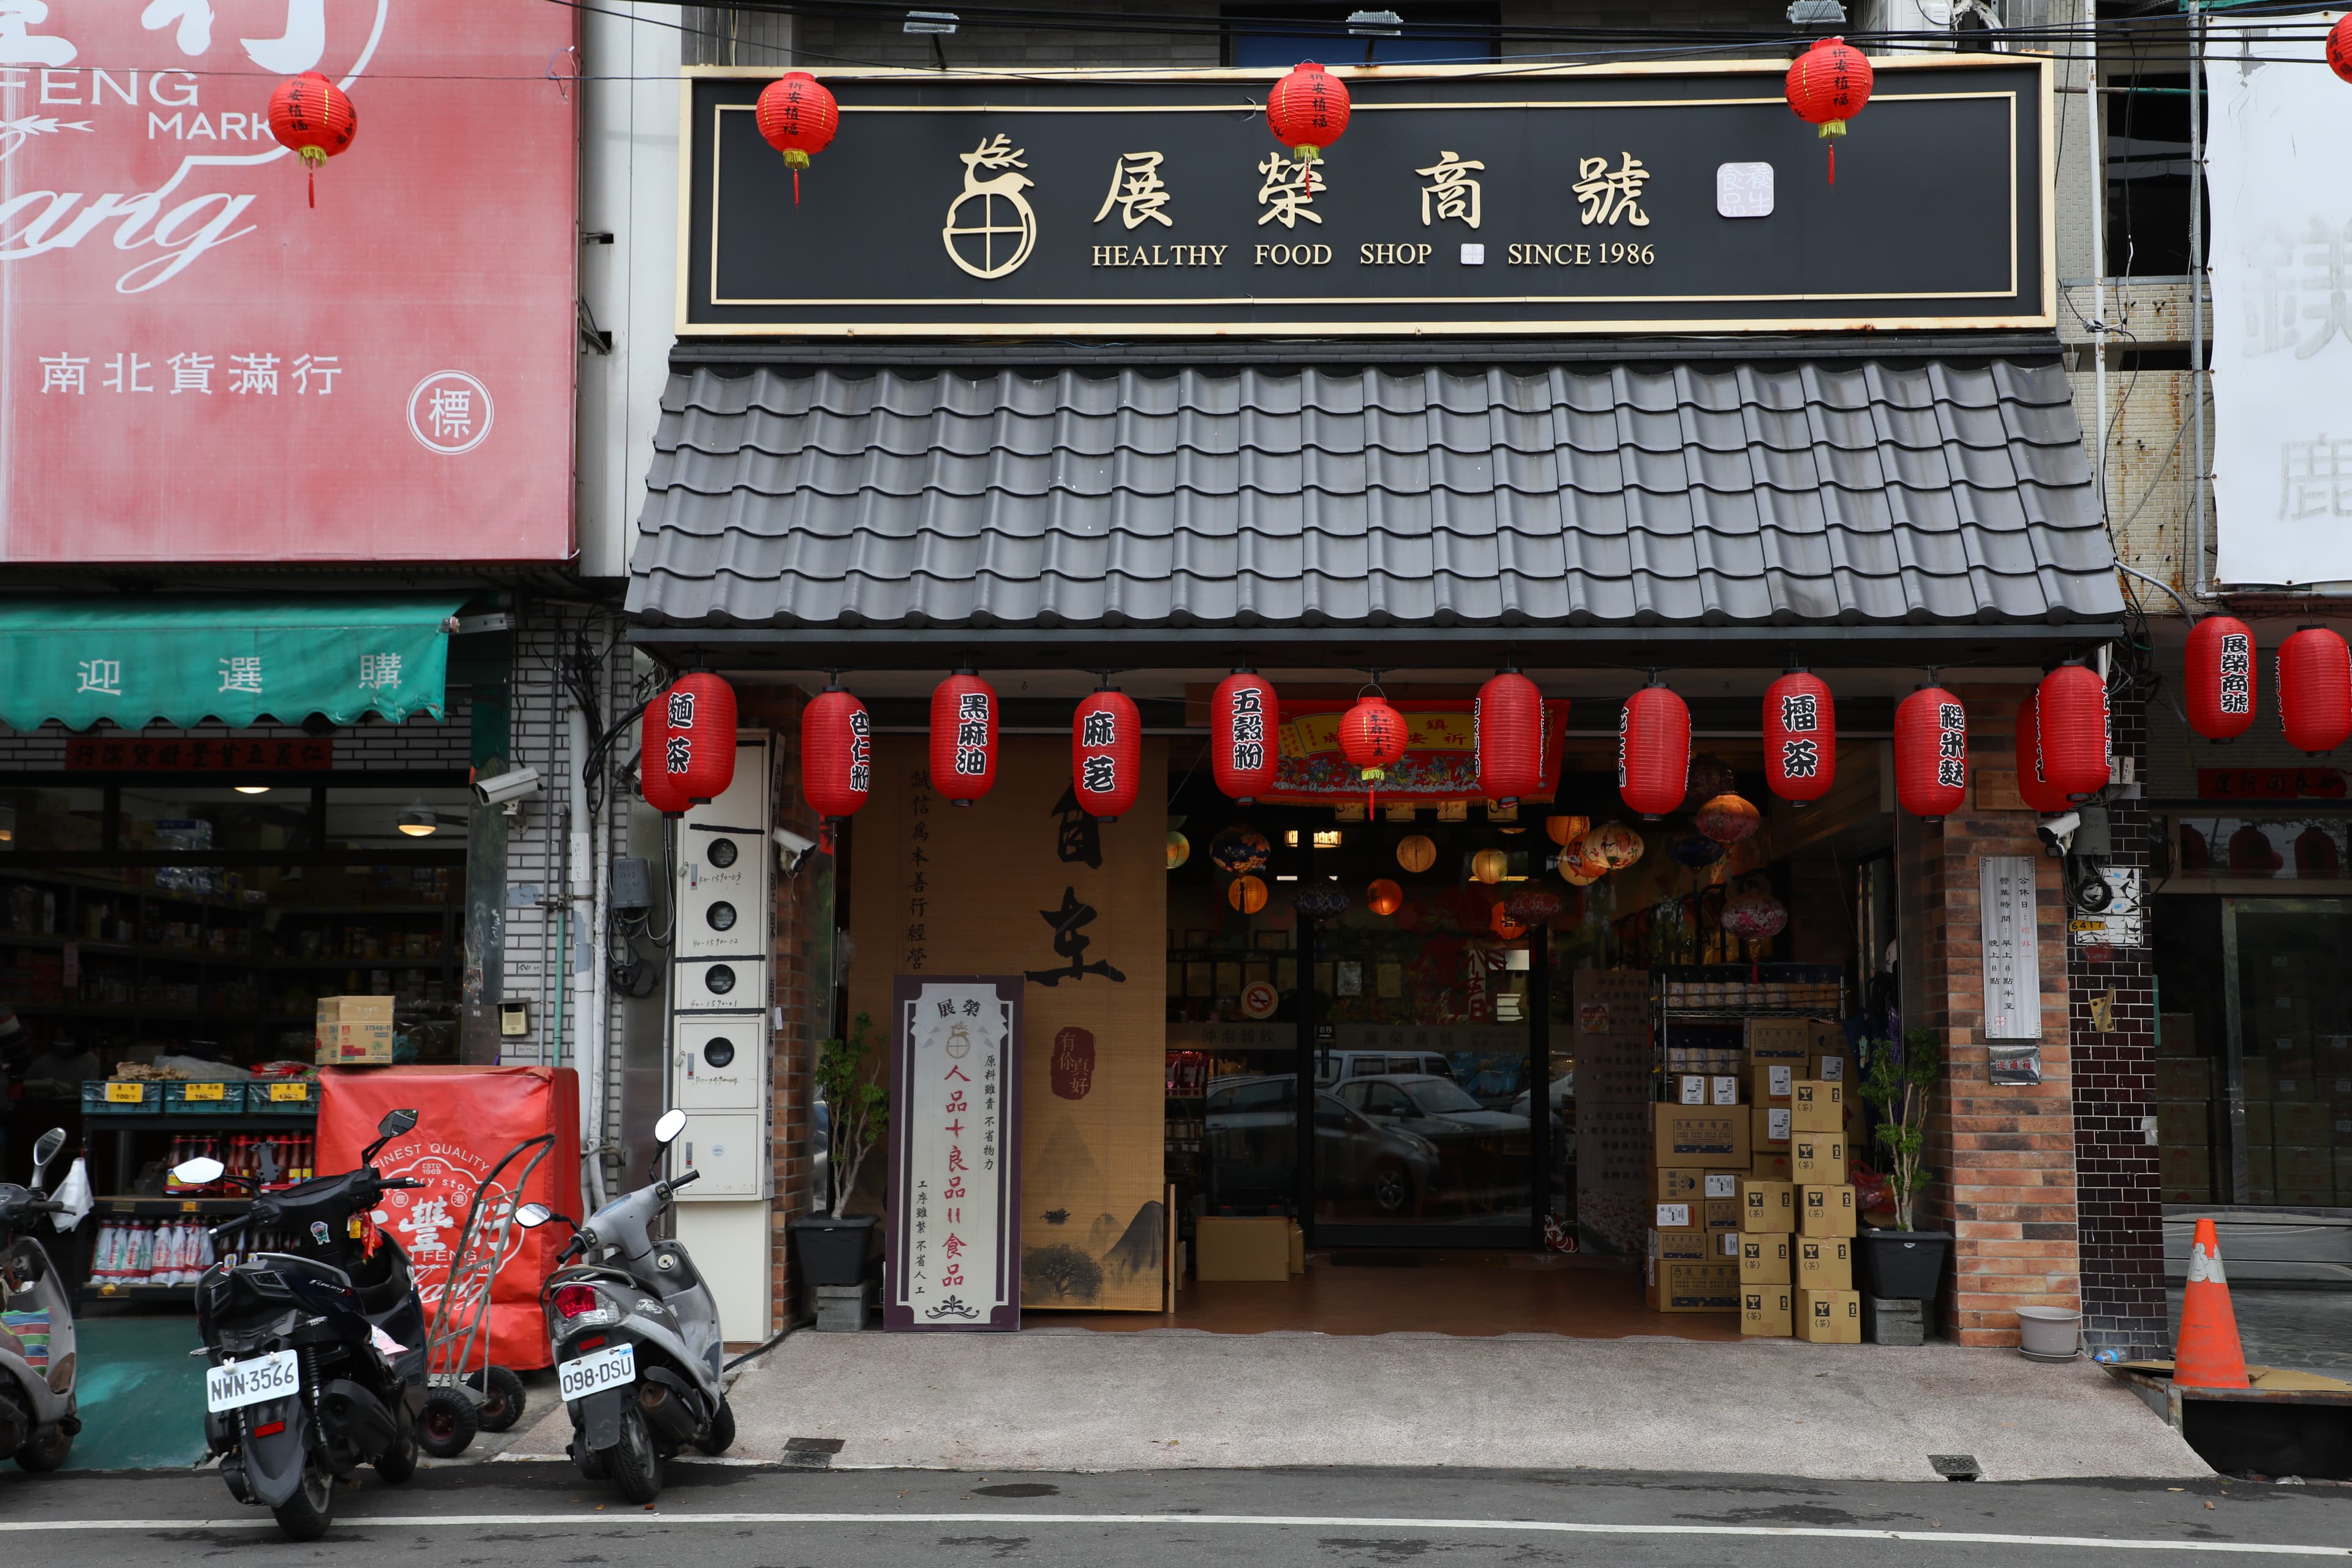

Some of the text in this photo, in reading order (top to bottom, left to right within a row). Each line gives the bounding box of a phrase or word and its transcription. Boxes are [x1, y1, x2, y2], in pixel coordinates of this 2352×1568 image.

[1093, 151, 1650, 230] 展榮商號
[1092, 245, 1228, 267] HEALTHY
[1254, 244, 1332, 266] FOOD
[1360, 243, 1432, 265] SHOP
[1508, 243, 1591, 266] SINCE
[1597, 242, 1655, 265] 1986
[39, 351, 342, 396] 南北貨滿行
[428, 387, 472, 438] 標
[2220, 633, 2248, 715] 展榮商號
[666, 692, 696, 775] 麵茶
[850, 710, 870, 793] 杏仁粉
[956, 693, 989, 775] 黑麻油
[1232, 688, 1264, 770] 五穀粉
[1782, 694, 1818, 778] 擂茶
[2071, 921, 2103, 930] 6417
[429, 1142, 491, 1172] QUALITY
[211, 1362, 295, 1402] NWN-3566
[563, 1356, 631, 1395] 098-DSU
